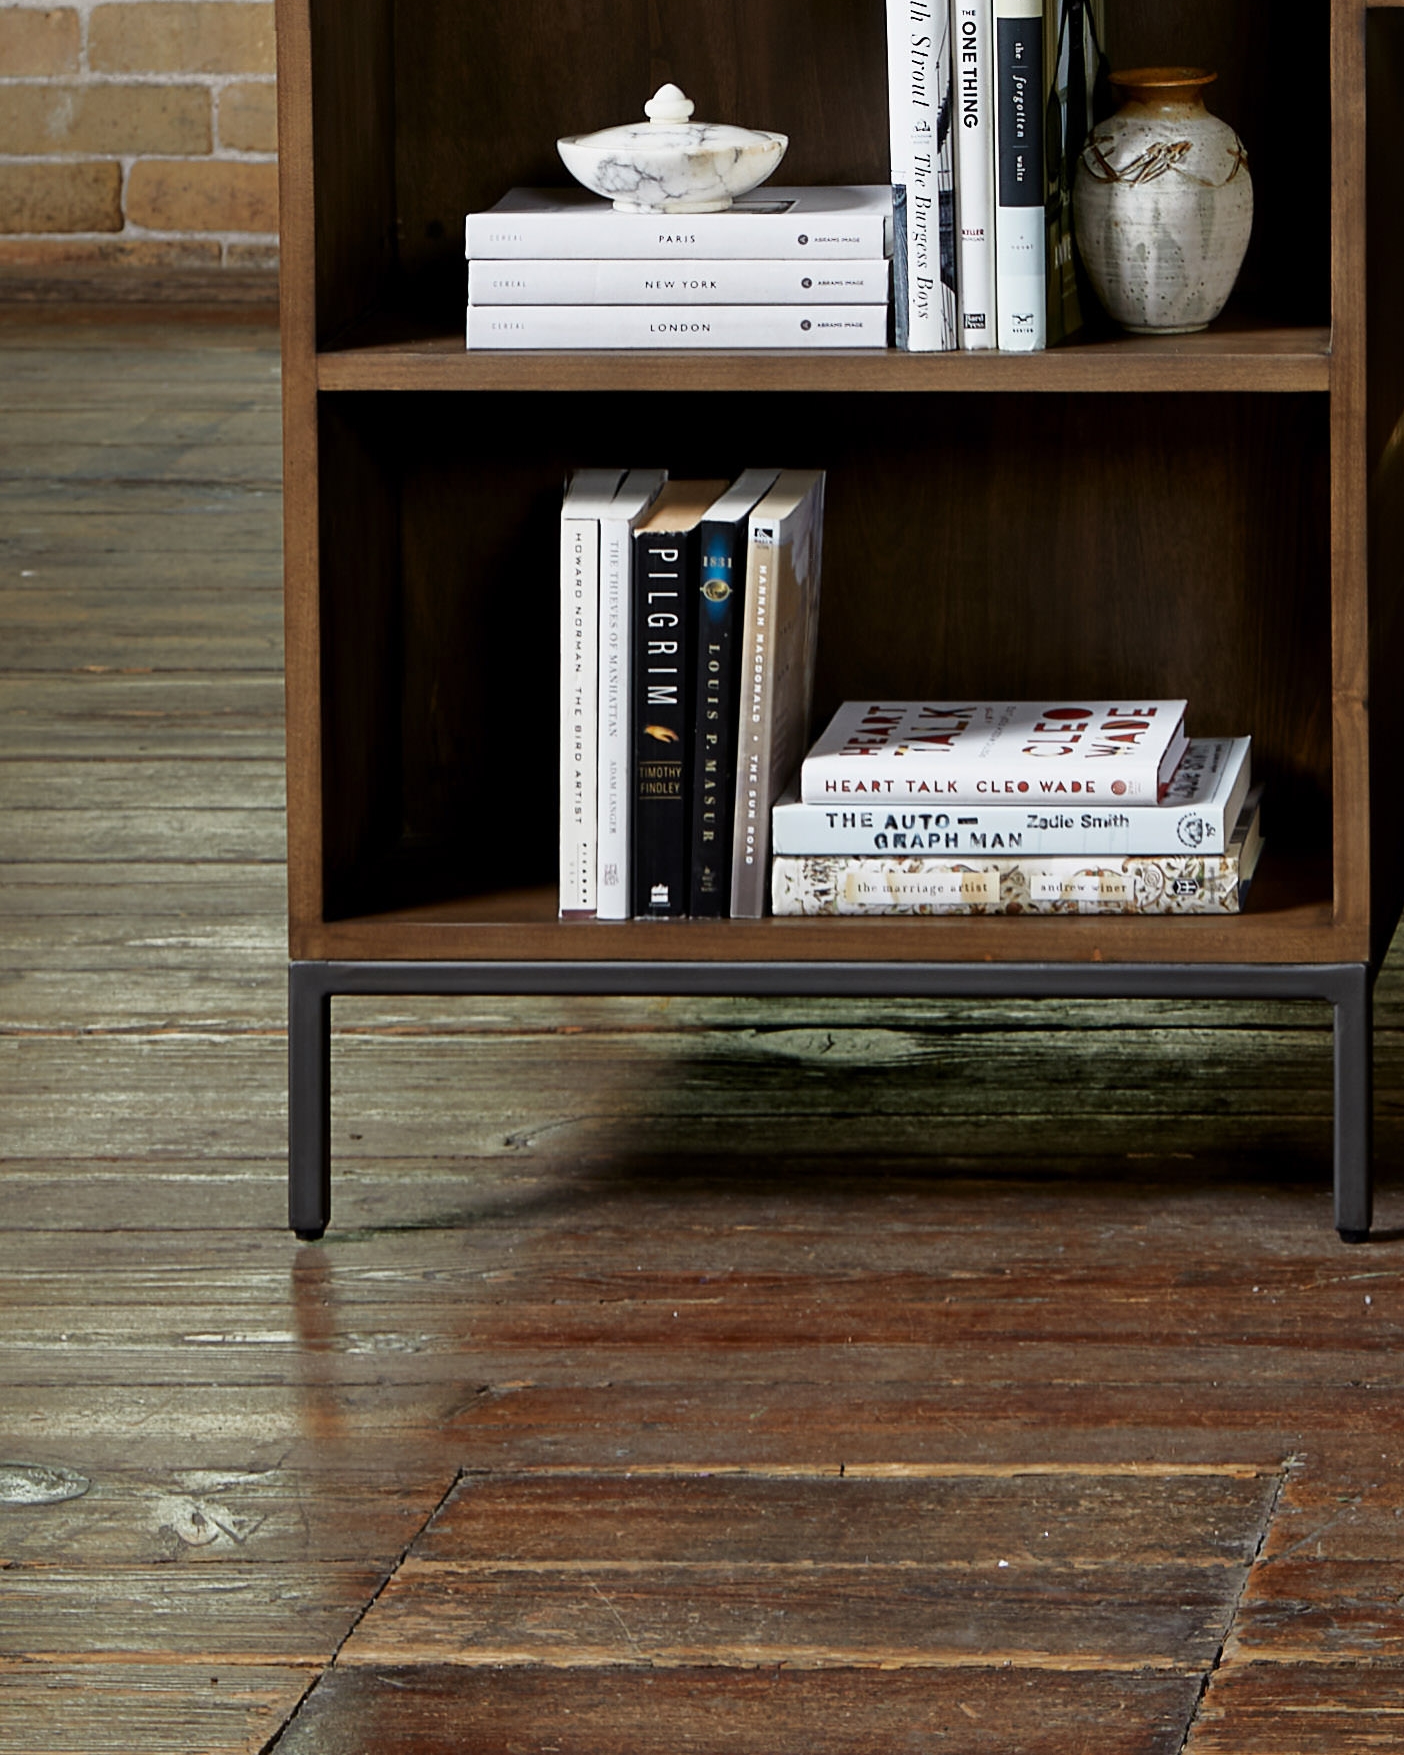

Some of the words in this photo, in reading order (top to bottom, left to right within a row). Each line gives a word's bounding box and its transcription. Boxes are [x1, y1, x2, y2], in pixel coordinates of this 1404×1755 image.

[961, 9, 976, 17] THE
[961, 20, 977, 63] ONE
[1015, 41, 1025, 60] the
[962, 67, 979, 129] THING
[1011, 74, 1027, 138] forgotten
[913, 152, 933, 188] The
[1016, 154, 1026, 182] waltz
[658, 234, 697, 244] PARIS
[912, 194, 933, 270] Burgess
[645, 280, 676, 289] NEW
[681, 280, 718, 289] YORK
[912, 275, 934, 320] Boys
[649, 323, 712, 332] LONDON
[574, 532, 583, 598] HOWARD
[608, 540, 619, 569] THE
[703, 555, 733, 569] 1831
[608, 571, 619, 627] THIEVES
[756, 564, 768, 627] HANNAH
[574, 606, 583, 673] NORMAN
[647, 548, 679, 705] PILGRIM
[608, 633, 618, 652] OF
[706, 644, 721, 720] LOUIS
[752, 633, 766, 724] MACDONALD
[574, 686, 583, 716] THE
[607, 654, 618, 738] MANHATTAN
[574, 724, 582, 762] BIRD
[705, 733, 718, 751] P.
[838, 705, 908, 757] HEART
[609, 760, 617, 791] ADAM
[639, 766, 683, 779] TIMOTHY
[749, 754, 759, 783] THE
[574, 770, 582, 824] ARTIST
[640, 782, 681, 794] FINDLEY
[703, 759, 717, 842] MASUR
[825, 780, 894, 794] HEART
[905, 780, 958, 794] TALK
[976, 780, 1030, 794] CLEO
[1040, 780, 1096, 794] WADE
[748, 790, 757, 819] SUN
[825, 812, 874, 829] THE
[1026, 814, 1074, 830] Zadie
[1080, 813, 1130, 829] Smith
[745, 826, 756, 865] ROAD
[873, 832, 959, 850] GRAPH
[969, 832, 1023, 849] MAN
[857, 882, 878, 894] the
[882, 882, 944, 896] marriage
[949, 882, 989, 894] artist
[1040, 882, 1086, 894] andrew
[1091, 882, 1127, 894] winer
